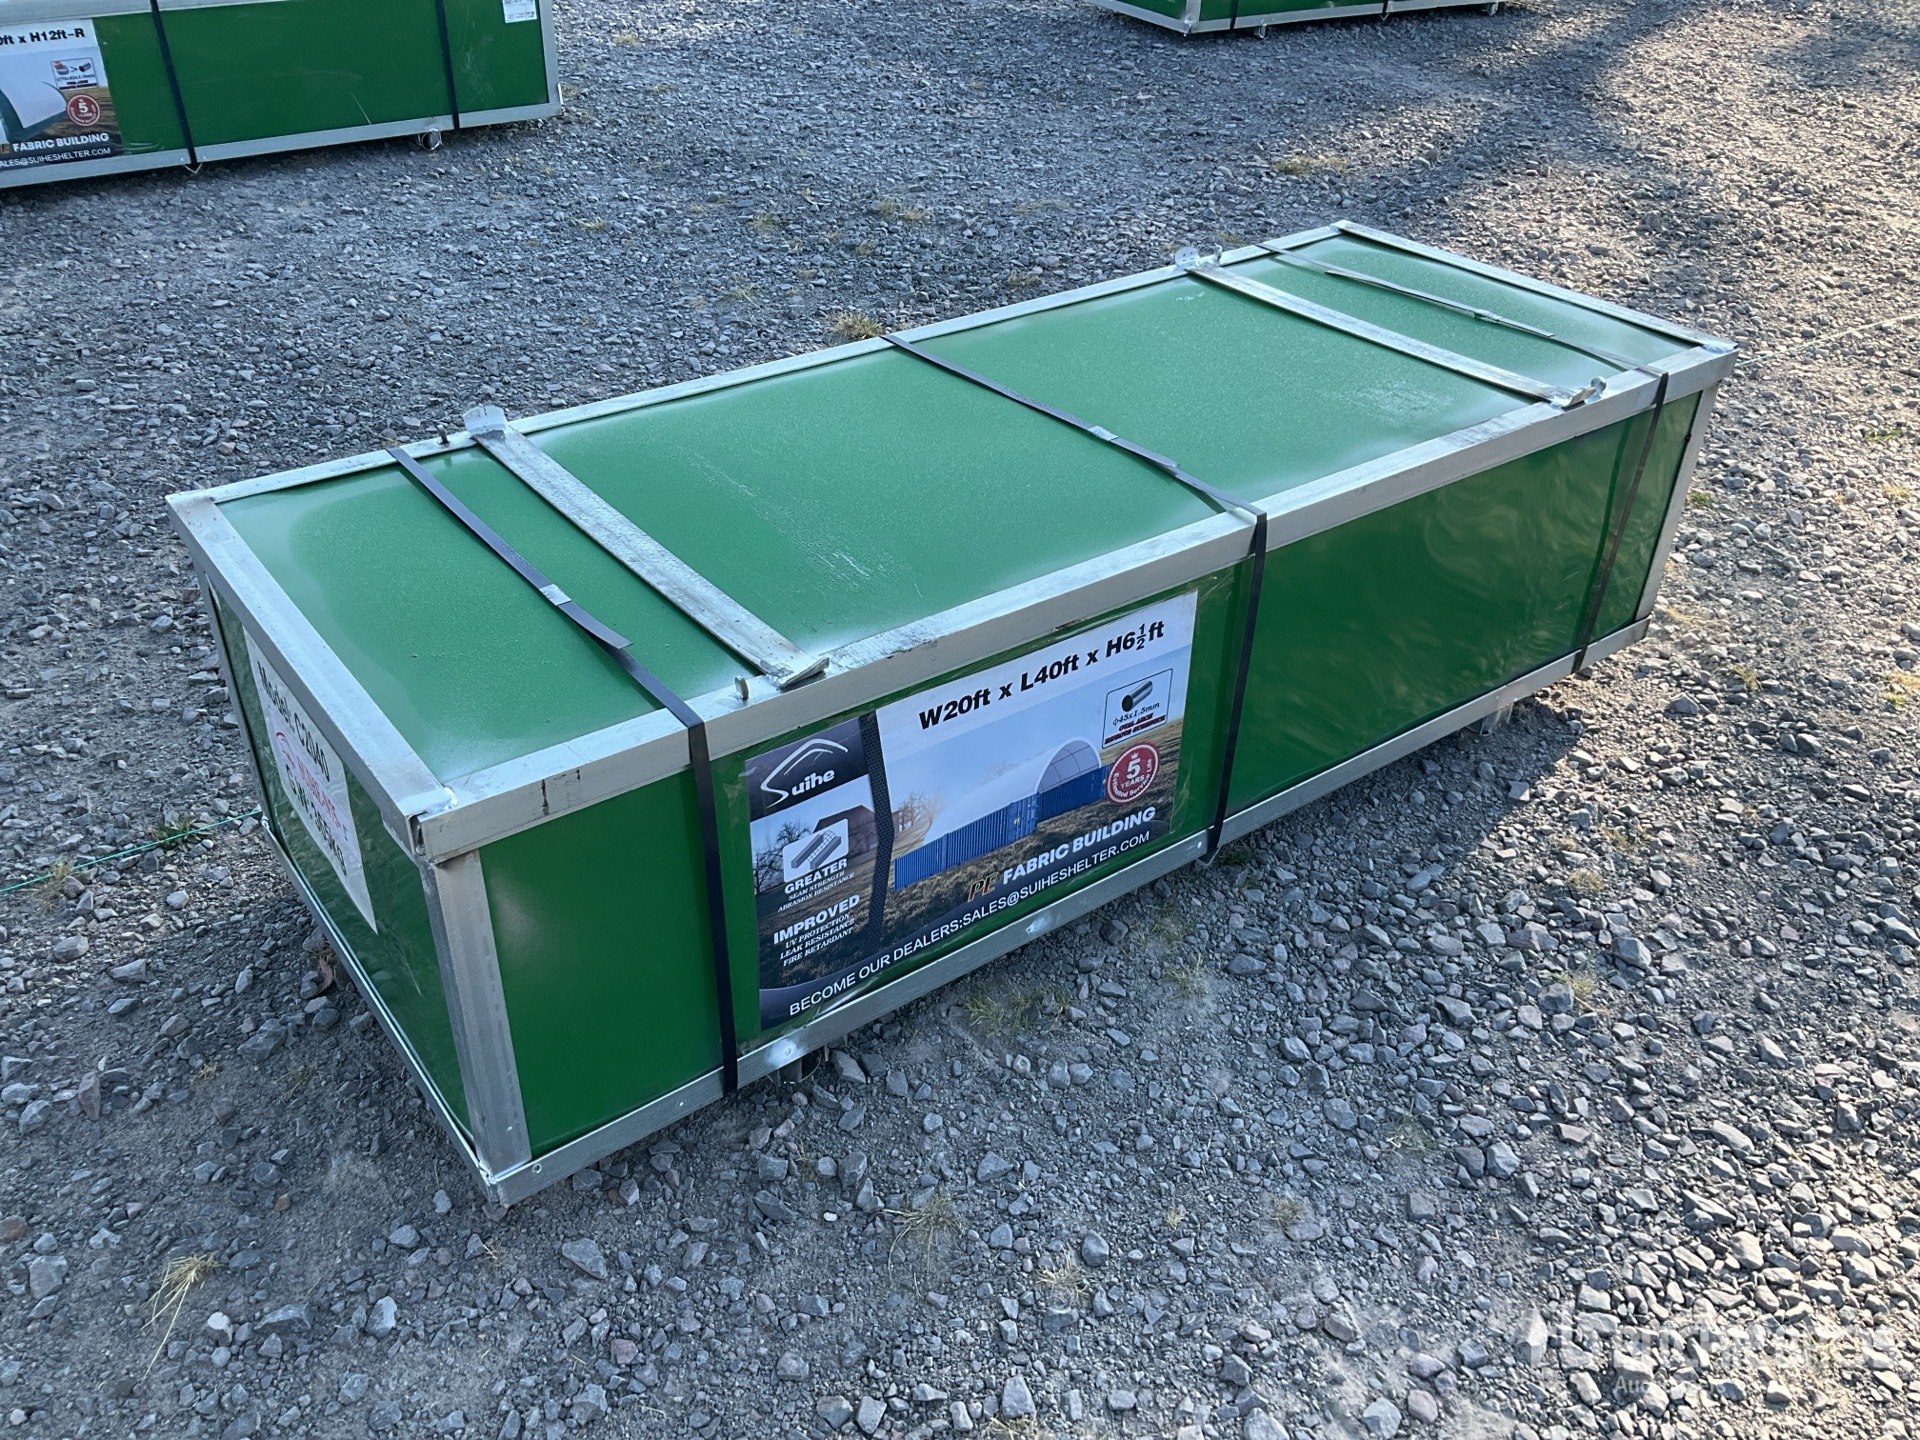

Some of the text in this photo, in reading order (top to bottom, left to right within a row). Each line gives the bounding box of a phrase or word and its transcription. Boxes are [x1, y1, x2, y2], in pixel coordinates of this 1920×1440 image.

[78, 102, 88, 113] 5
[12, 139, 54, 152] FABRIC
[56, 132, 110, 147] BUILDING
[919, 688, 990, 730] W20ft
[998, 682, 1013, 701] x
[1021, 653, 1079, 691] L40ft
[1085, 648, 1100, 667] x
[1120, 774, 1145, 789] YEARS
[1126, 757, 1141, 779] 5
[967, 806, 1156, 903] PE FABRIC BUILDING
[778, 872, 855, 912] ABRASION RESISTANCE
[784, 858, 848, 894] GREATER
[788, 870, 845, 901] SEAM STRENGTH
[773, 894, 860, 945] IMPROVED
[780, 917, 855, 960] LEAK RESISTANCE
[785, 912, 851, 949] UV PROTECTION
[783, 927, 854, 967] FIRE RETARDANT
[789, 972, 856, 1016] BECOME
[859, 954, 890, 979] OUR
